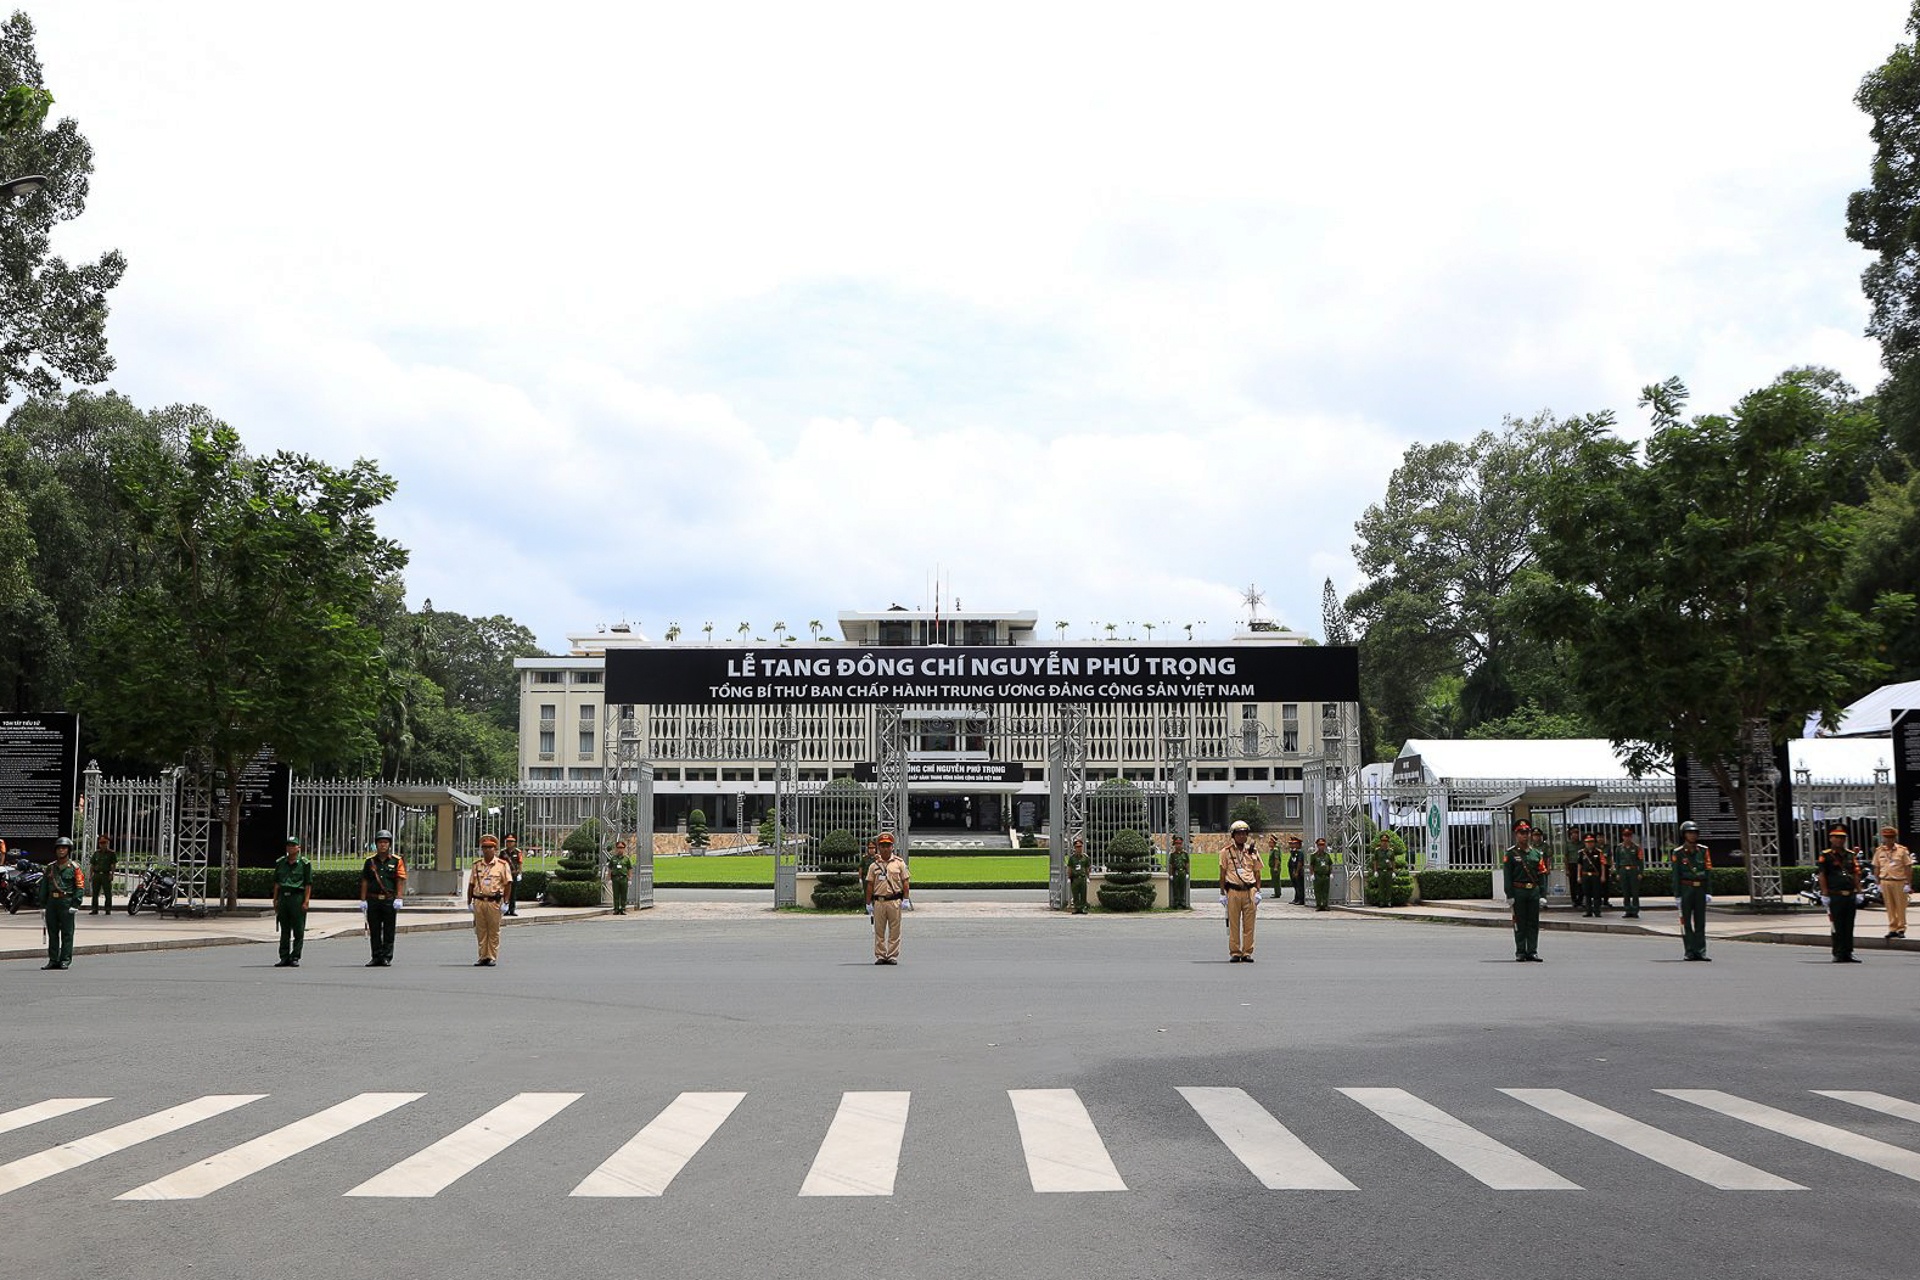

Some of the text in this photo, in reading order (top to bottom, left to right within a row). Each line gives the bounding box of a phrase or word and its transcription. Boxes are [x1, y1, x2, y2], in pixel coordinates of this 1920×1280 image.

[728, 651, 1236, 681] LỄ TANG ĐỒNG CHÍ NGUYỄN PHÚ TRỌNG
[709, 681, 1255, 700] TỔNG BÍ THƯ BAN CHẤP HÀNH TRUNG ƯƠNG ĐẢNG CỘNG SẢN VIỆT NAM
[936, 762, 965, 773] NGUYỄN
[982, 765, 1006, 775] TRỌNG
